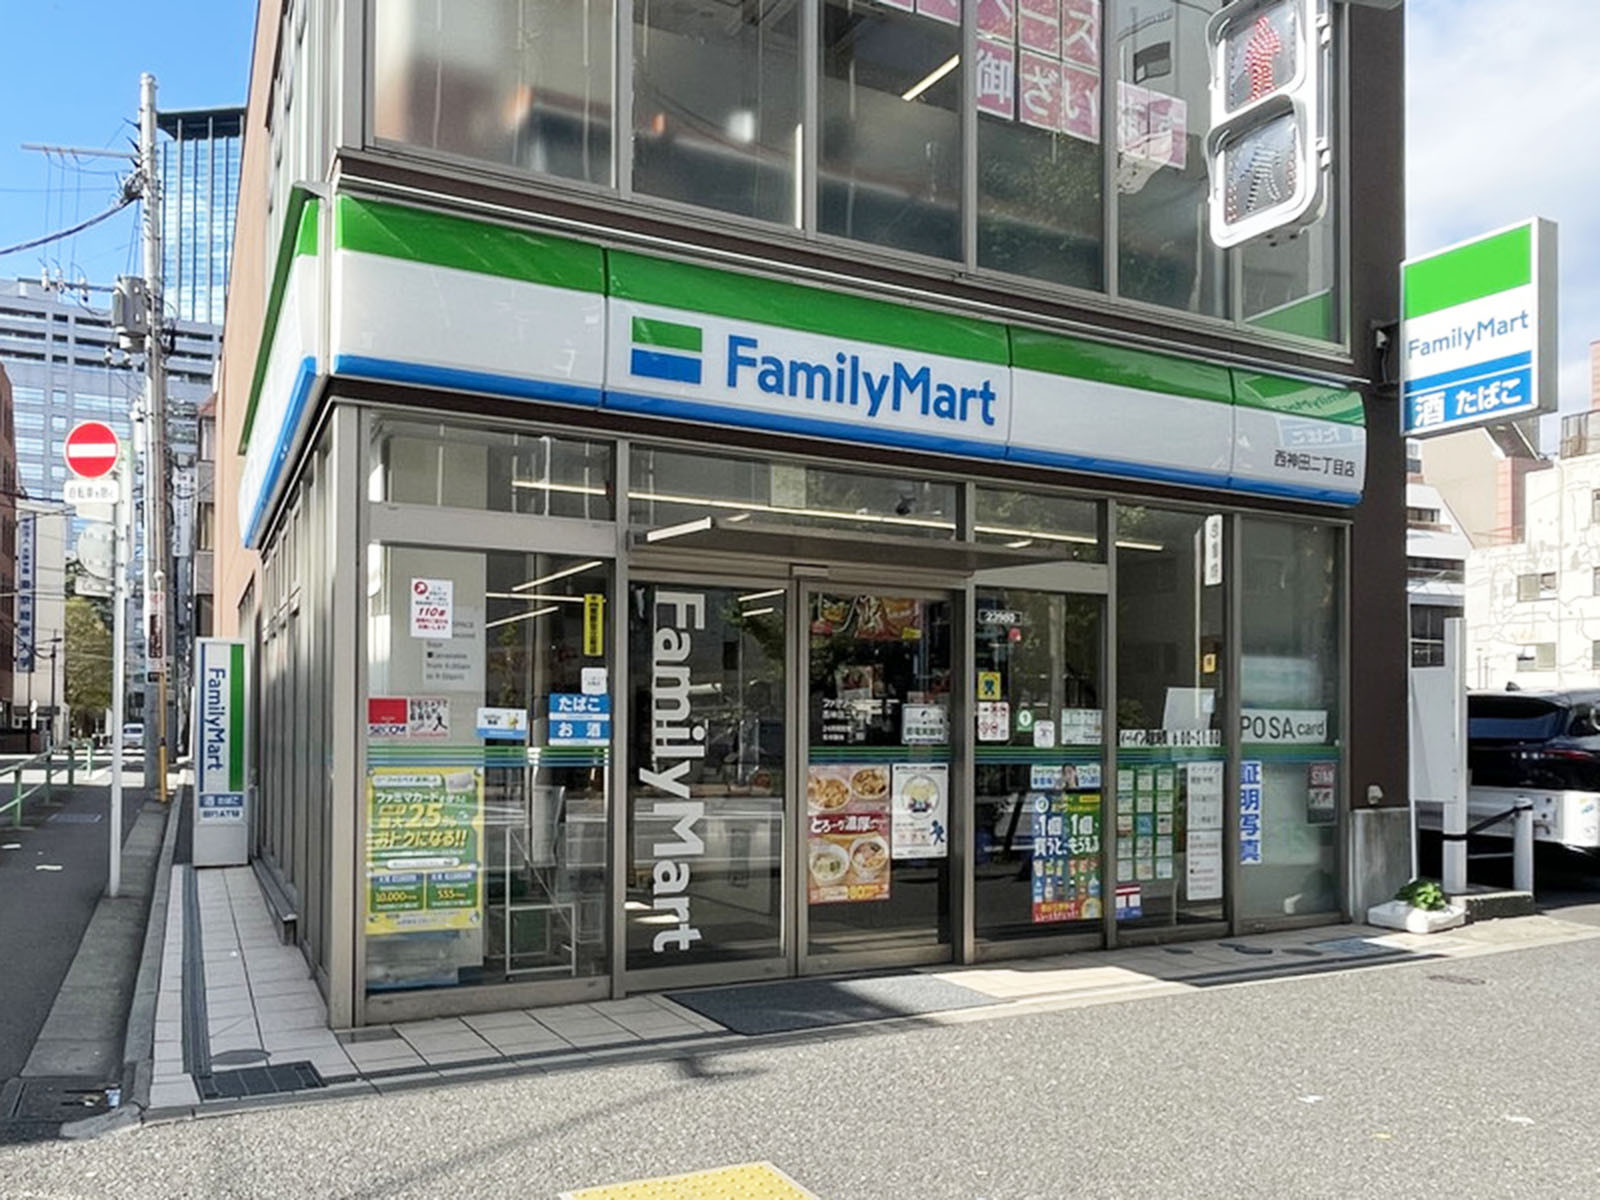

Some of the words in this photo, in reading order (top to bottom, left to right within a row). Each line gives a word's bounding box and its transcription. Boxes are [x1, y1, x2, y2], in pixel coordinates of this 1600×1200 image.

[1408, 307, 1530, 359] FamilyMart
[726, 333, 996, 426] FamilyMart
[1415, 393, 1445, 428] 酒
[1455, 377, 1523, 416] たばこ
[1273, 449, 1356, 479] 西神田二丁目店
[207, 667, 226, 771] FamilyMart
[557, 696, 601, 711] たばこ
[1240, 715, 1296, 740] POSA
[1297, 722, 1324, 736] card
[640, 590, 709, 955] FamilyMart
[405, 804, 443, 828] 25
